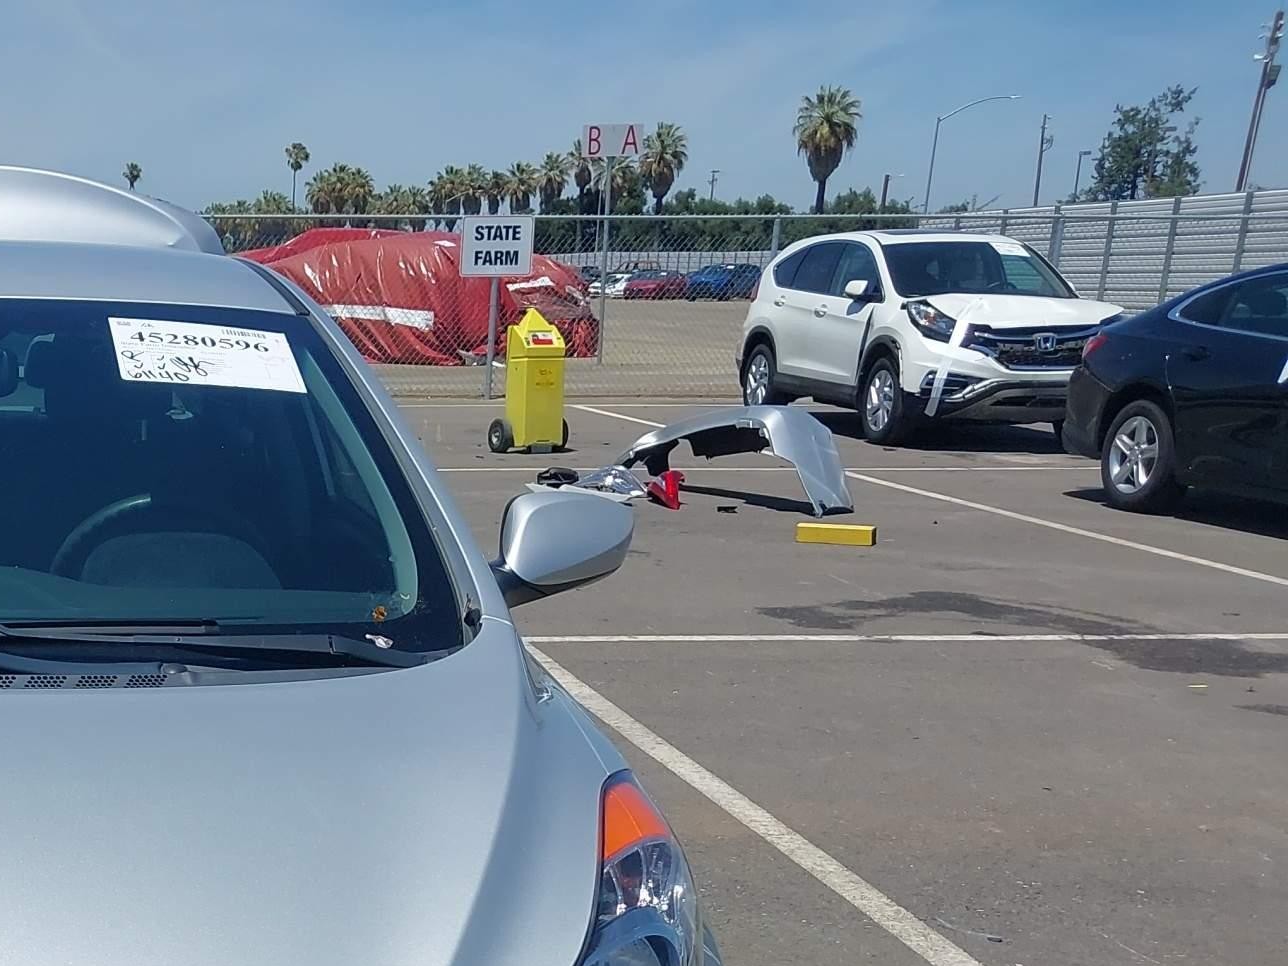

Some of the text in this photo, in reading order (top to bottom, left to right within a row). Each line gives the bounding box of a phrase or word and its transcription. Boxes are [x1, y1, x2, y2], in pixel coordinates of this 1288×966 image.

[589, 124, 638, 155] B A
[474, 225, 522, 241] STATE
[474, 250, 520, 266] FARM
[130, 331, 269, 352] 45280596
